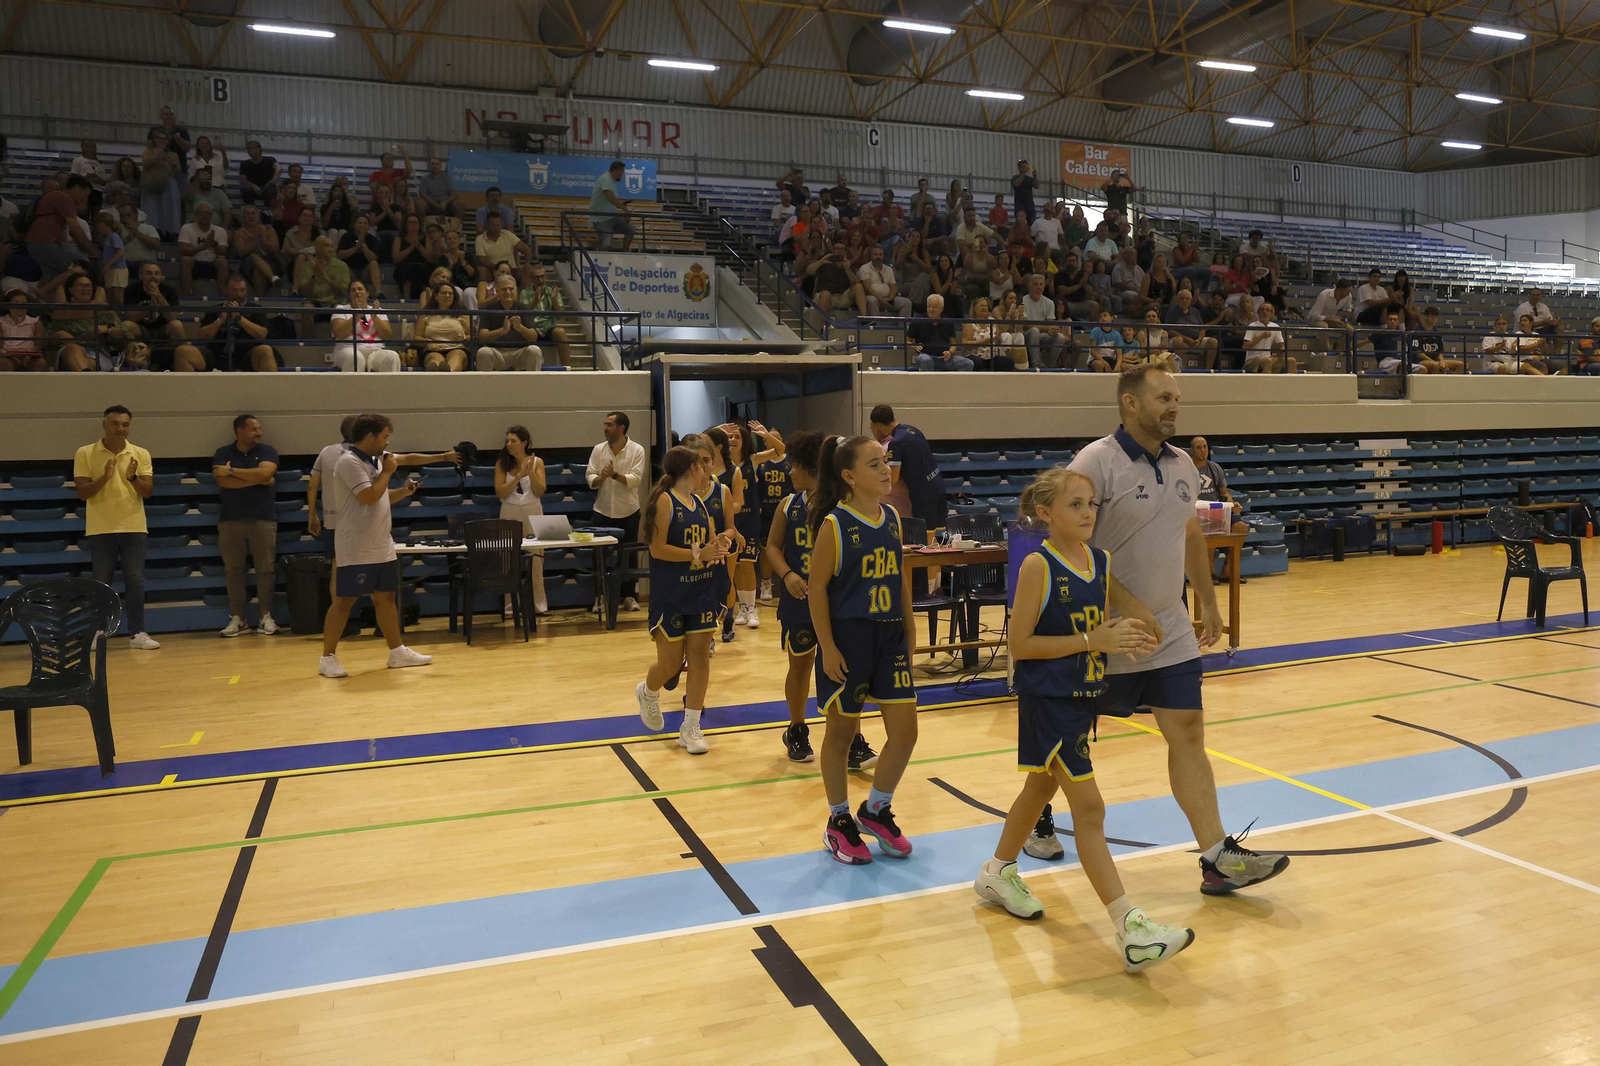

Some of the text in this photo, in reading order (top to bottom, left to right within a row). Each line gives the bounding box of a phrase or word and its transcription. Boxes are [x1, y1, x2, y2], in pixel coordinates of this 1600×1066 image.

[213, 78, 228, 101] B
[543, 114, 680, 148] FUMAR
[869, 129, 878, 146] C
[1084, 145, 1108, 160] Bar
[453, 167, 498, 175] Ayuntamiento
[462, 174, 498, 182] Algeciras
[552, 172, 595, 180] Ayuntamiento
[1293, 165, 1300, 182] D
[561, 179, 595, 187] Algeciras
[615, 266, 677, 280] Delegación
[612, 282, 679, 294] de Deportes
[655, 311, 665, 319] de
[667, 309, 709, 321] Algeciras
[764, 470, 786, 483] CBA
[767, 485, 782, 497] 89
[745, 546, 756, 555] 24
[861, 546, 899, 579] CBA
[868, 585, 891, 614] 10
[700, 610, 713, 624] 12
[1084, 651, 1105, 683] 15
[893, 671, 911, 688] 10
